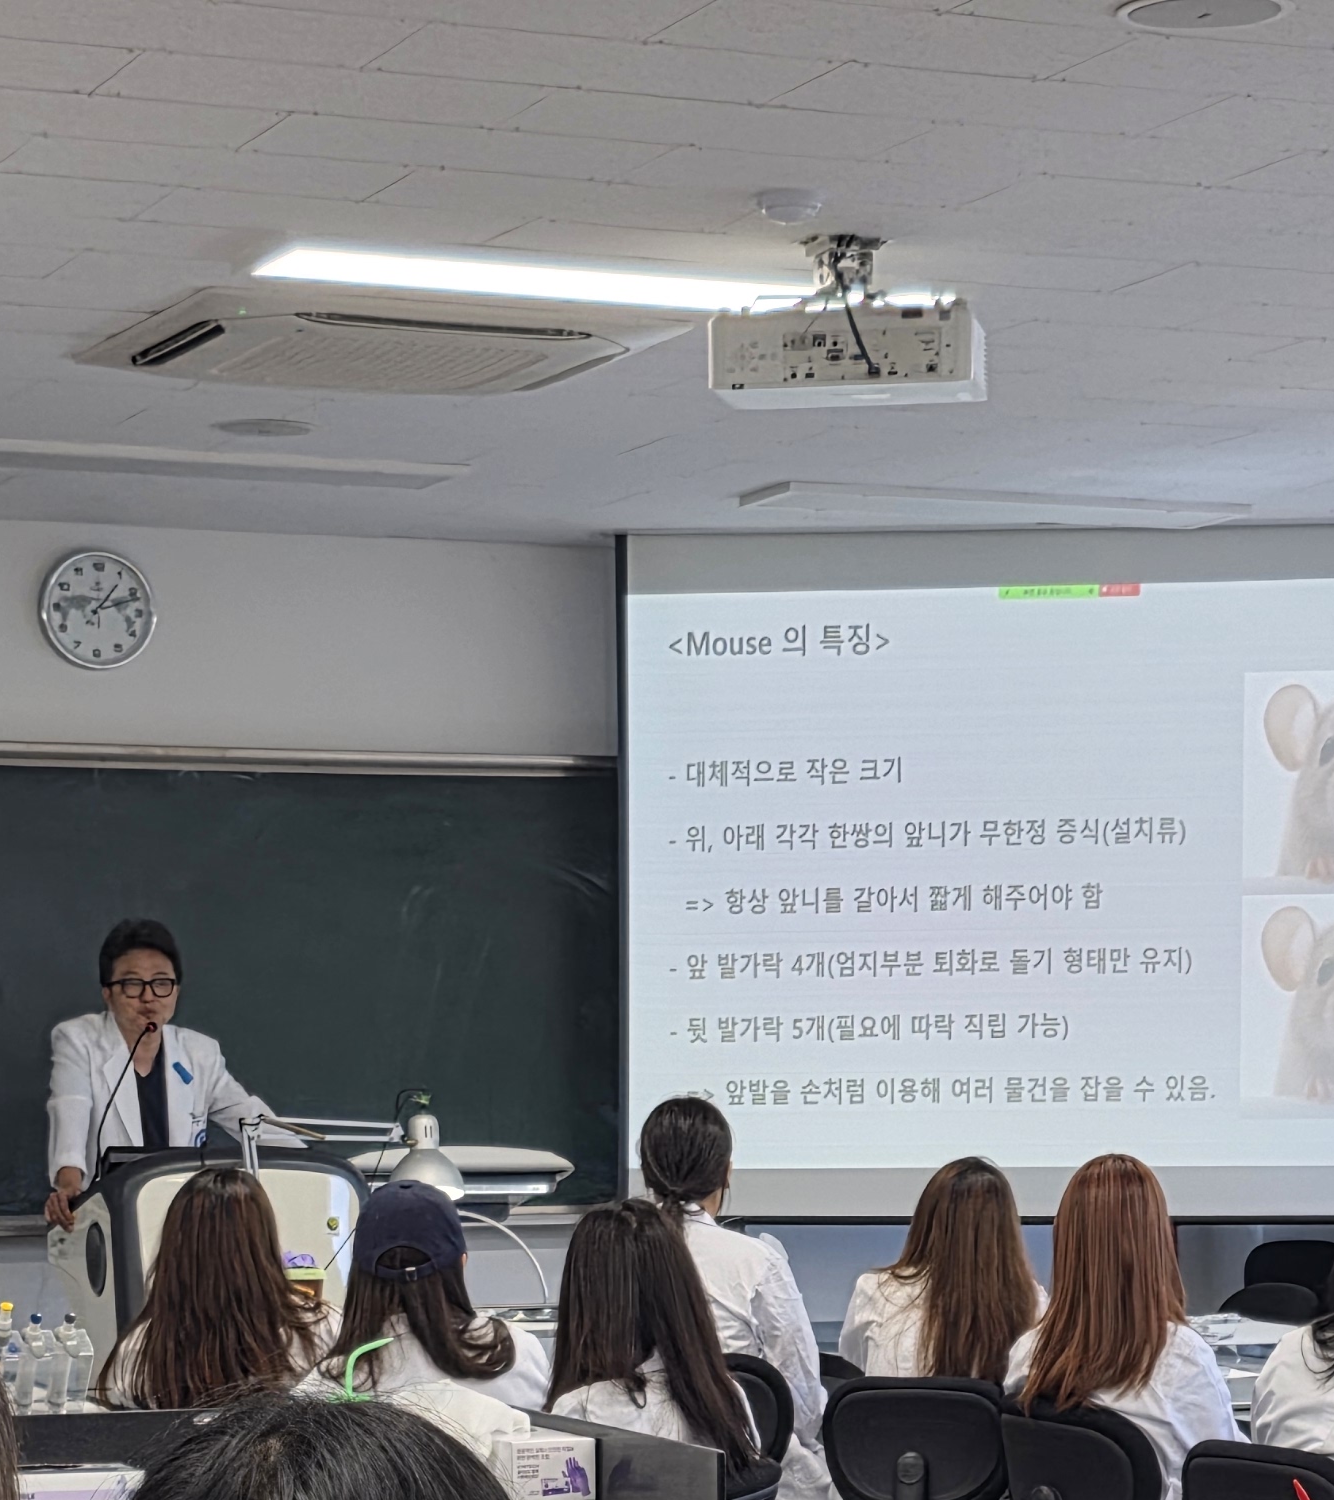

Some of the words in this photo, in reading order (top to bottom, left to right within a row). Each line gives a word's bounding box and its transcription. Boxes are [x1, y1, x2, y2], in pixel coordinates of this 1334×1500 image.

[668, 630, 772, 657] <Mouse
[781, 624, 807, 657] 의
[819, 622, 890, 657] 특징>
[686, 759, 798, 788] 대체적으로
[805, 757, 851, 786] 작은
[859, 756, 902, 784] 크기
[685, 825, 713, 854] 위,
[722, 823, 765, 852] 아래
[775, 822, 820, 851] 각각
[827, 821, 893, 850] 한쌍의
[904, 820, 972, 849] 앞니가
[979, 818, 1046, 847] 무한정
[1056, 816, 1187, 847] 증식(설치류)
[724, 887, 770, 915] 항상
[778, 886, 844, 915] 앞니를
[853, 885, 919, 914] 갈아서
[928, 884, 972, 912] 짧게
[982, 883, 1074, 912] 해주어야
[1080, 882, 1104, 910] 함
[686, 953, 709, 980] 앞
[717, 951, 784, 980] 발가락
[790, 950, 925, 980] 4개(엄지부분
[932, 948, 1000, 977] 퇴화로
[1009, 947, 1052, 975] 돌기
[1062, 947, 1131, 975] 형태만
[1139, 946, 1192, 975] 유지)
[686, 1016, 708, 1044] 뒷
[717, 1015, 784, 1043] 발가락
[792, 1014, 901, 1044] 5개(필요에
[911, 1013, 956, 1041] 따락
[964, 1012, 1006, 1041] 직립
[1017, 1012, 1069, 1041] 가능)
[725, 1079, 791, 1106] 앞발을
[799, 1077, 865, 1106] 손처럼
[875, 1077, 941, 1105] 이용해
[951, 1076, 994, 1105] 여러
[1003, 1076, 1071, 1103] 물건을
[1080, 1075, 1124, 1102] 잡을
[1132, 1075, 1155, 1103] 수
[1165, 1074, 1216, 1102] 있음.
